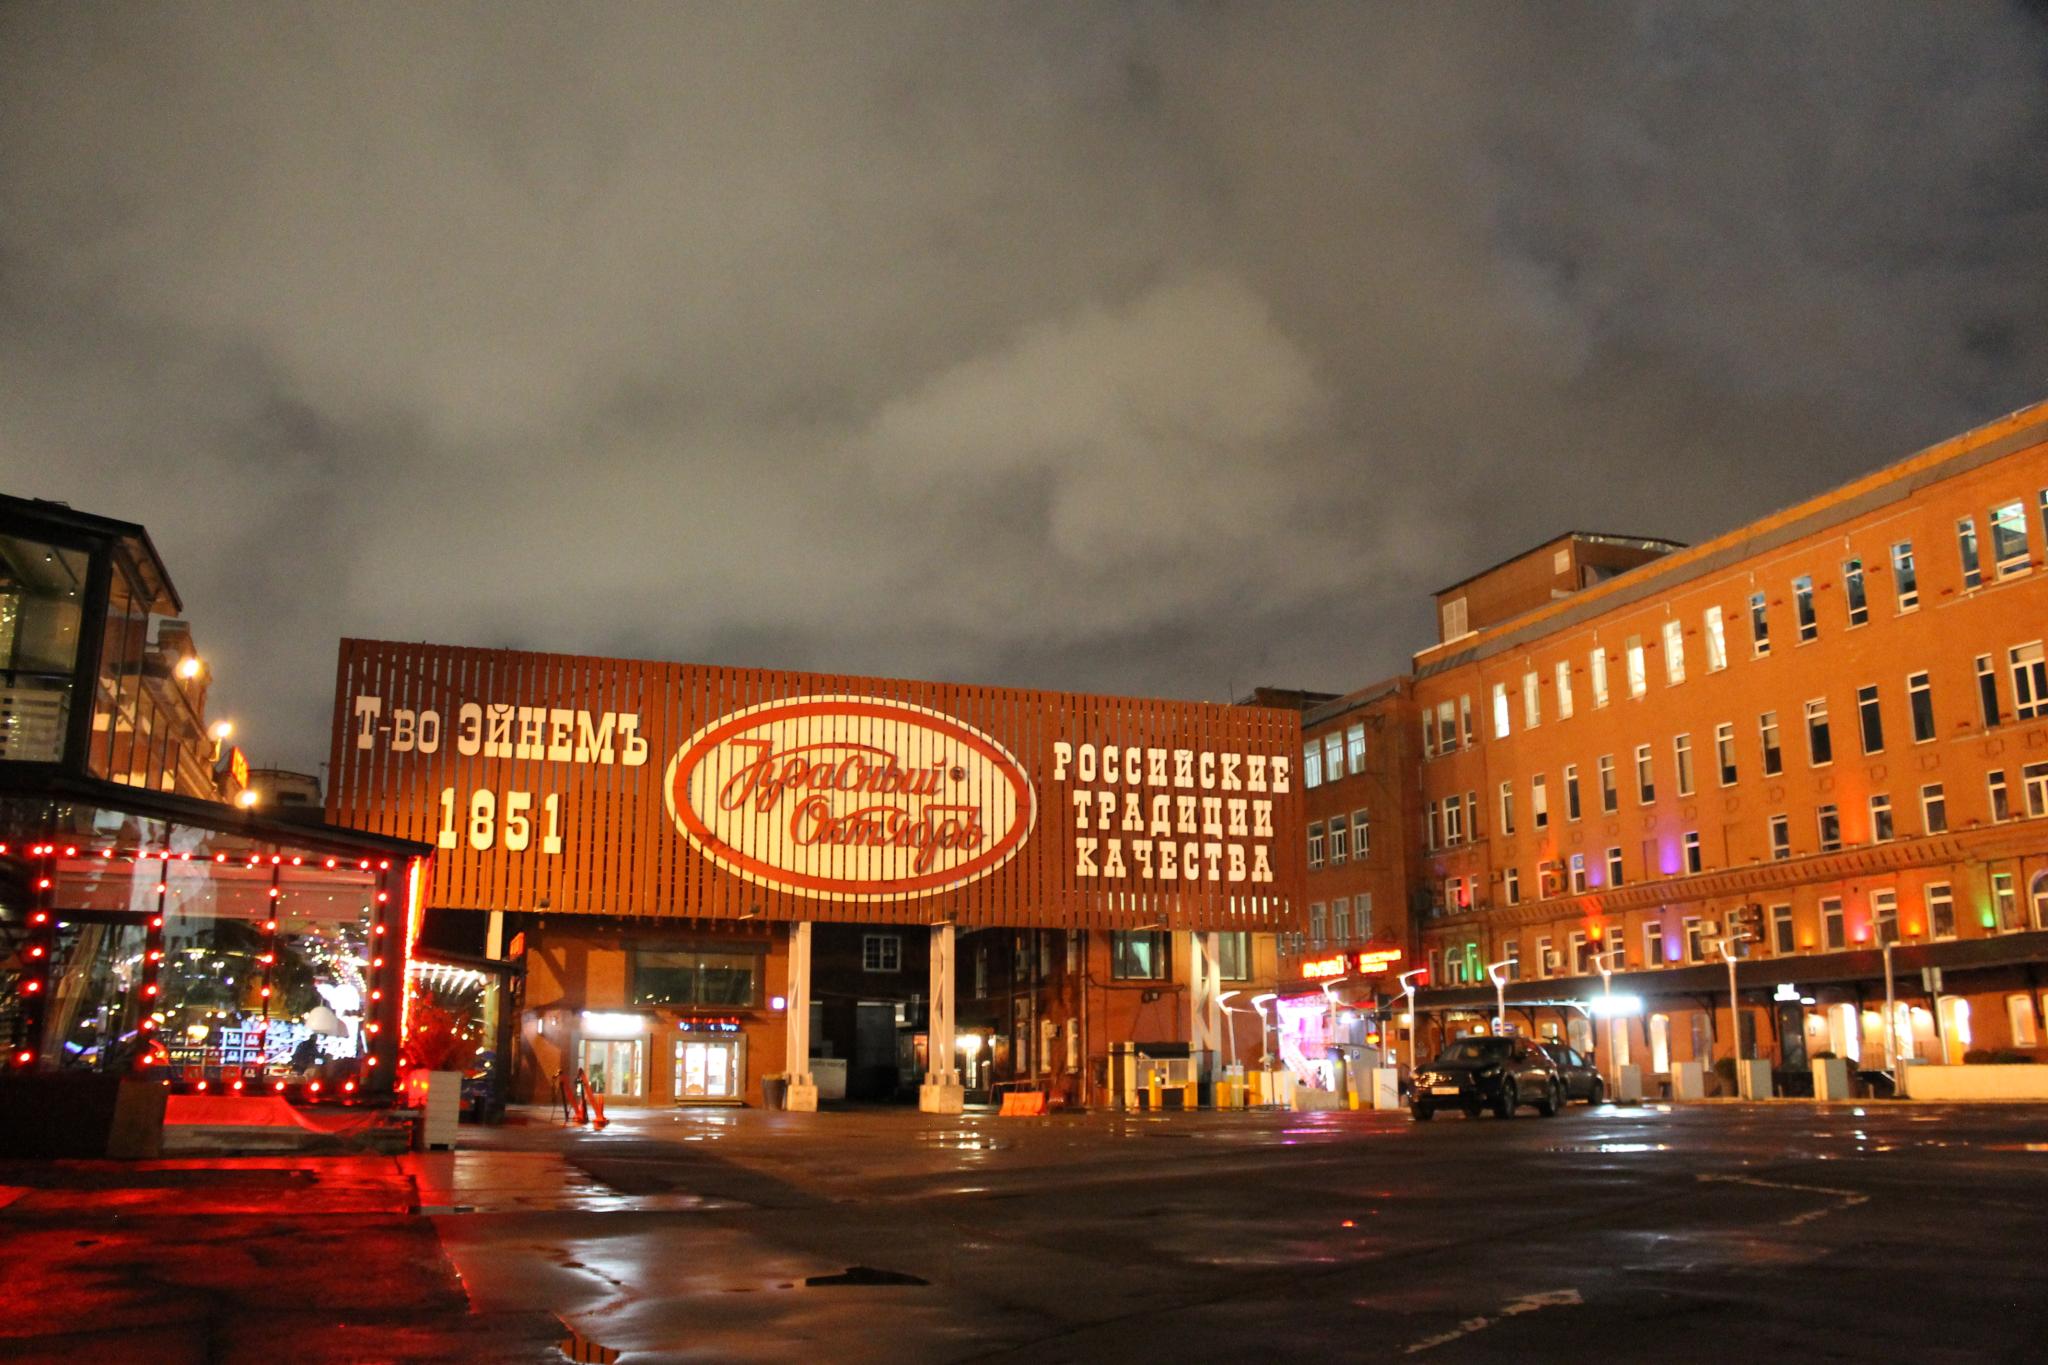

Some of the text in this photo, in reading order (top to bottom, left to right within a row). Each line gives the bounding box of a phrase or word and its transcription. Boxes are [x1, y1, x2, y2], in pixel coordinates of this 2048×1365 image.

[457, 702, 648, 767] ЭЙНЕМЪ
[1053, 741, 1290, 793] РОССИЙСКИЕ
[438, 787, 562, 854] 1851
[1073, 789, 1274, 840] ТРАДИЦИИ
[1076, 837, 1274, 883] КАЧЕСТВА
